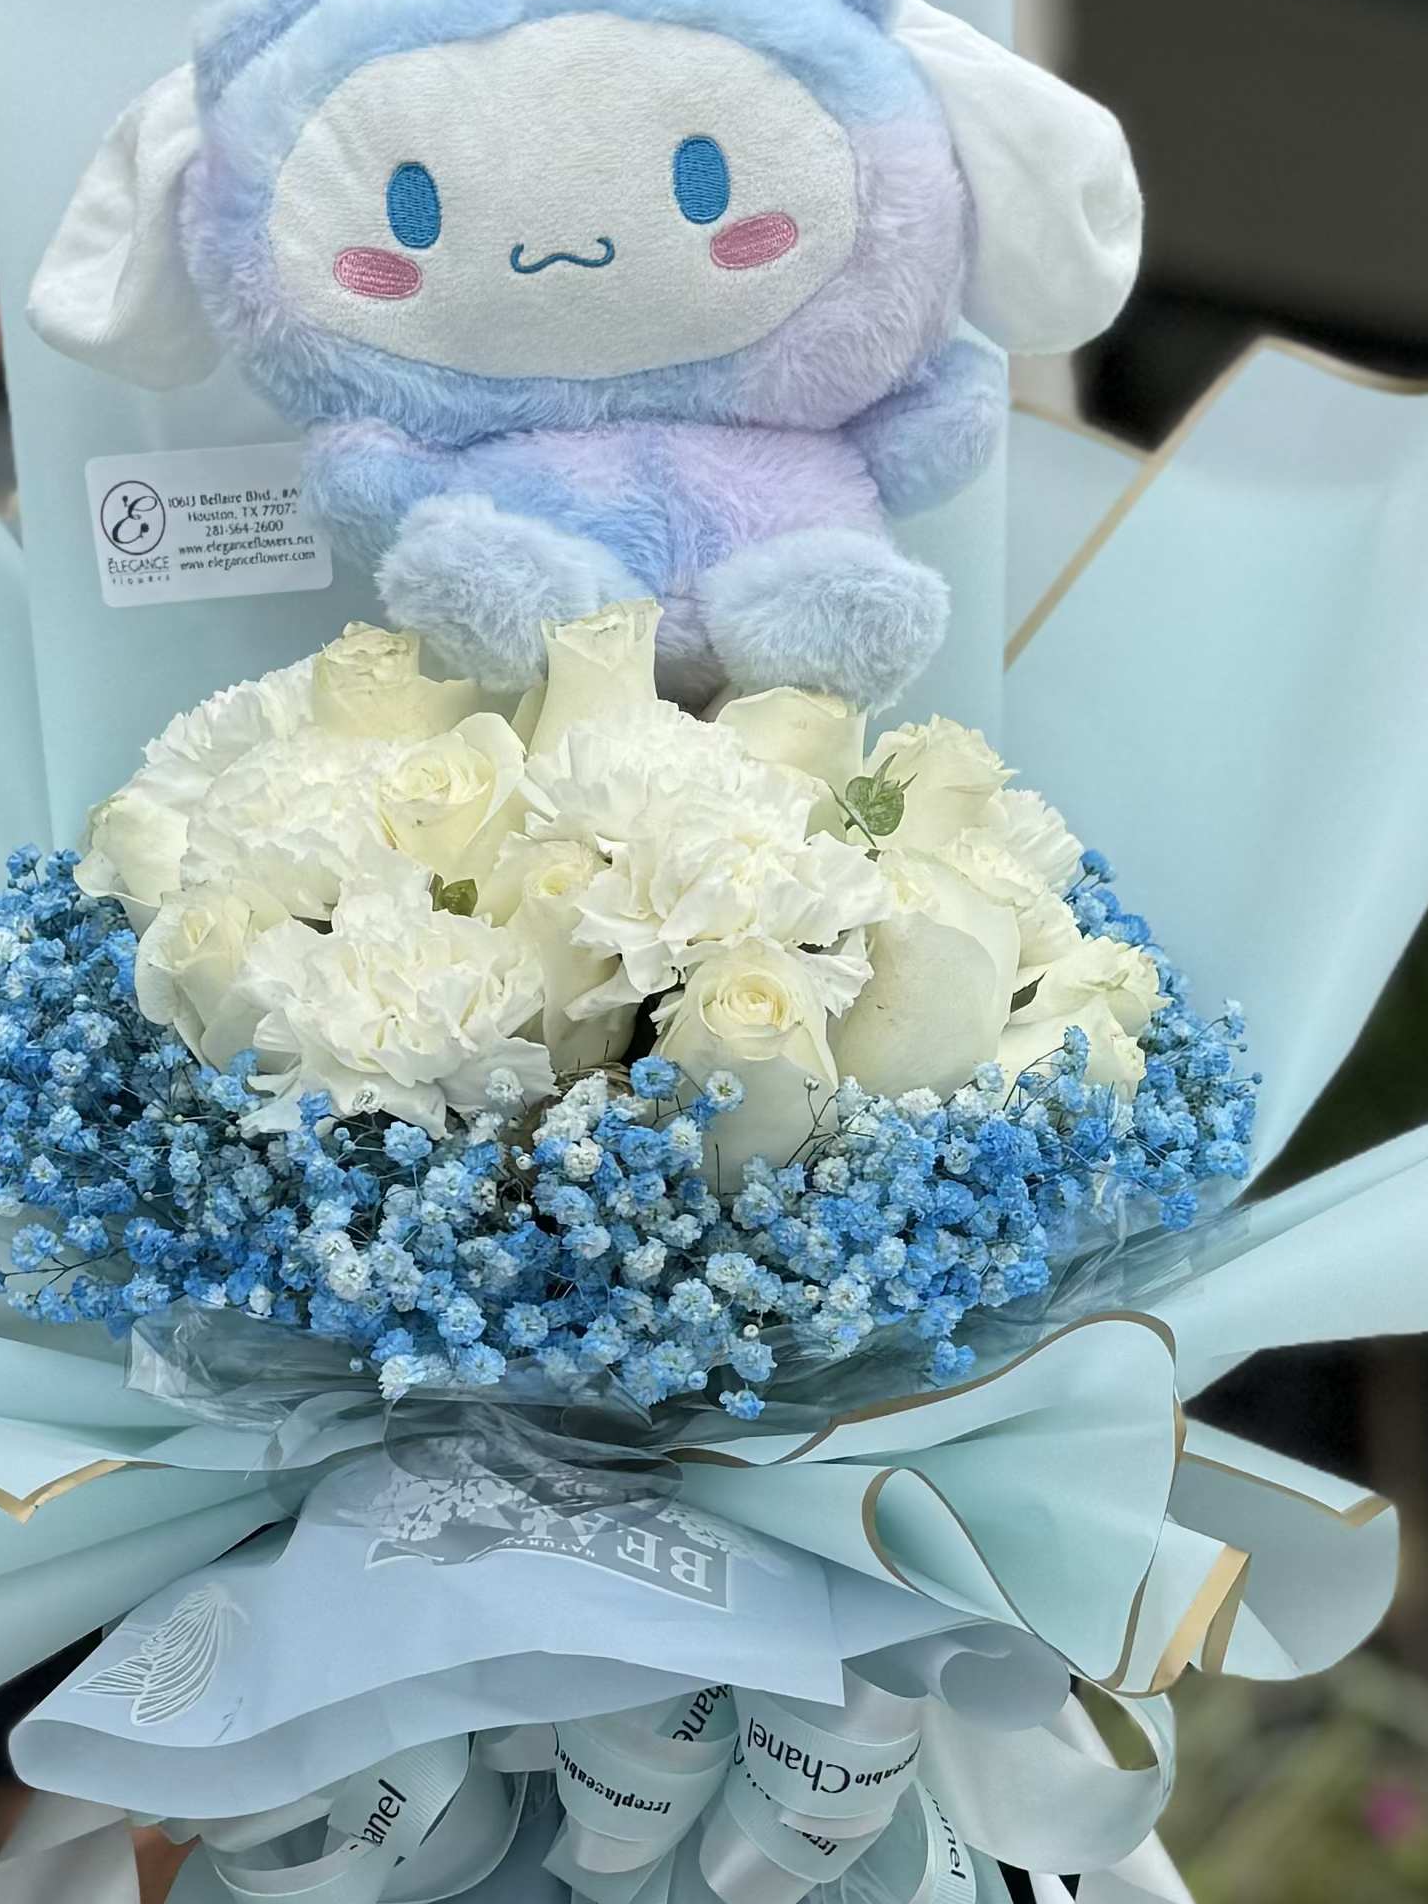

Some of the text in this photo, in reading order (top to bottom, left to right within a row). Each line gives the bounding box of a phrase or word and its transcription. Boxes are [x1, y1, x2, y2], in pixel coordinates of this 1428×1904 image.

[200, 492, 242, 506] Bellaire
[188, 510, 238, 522] Houston,
[243, 505, 258, 517] TX
[205, 519, 284, 537] 281-564-2600
[747, 1717, 851, 1793] Chanel
[558, 1749, 672, 1815] Irreplaceable
